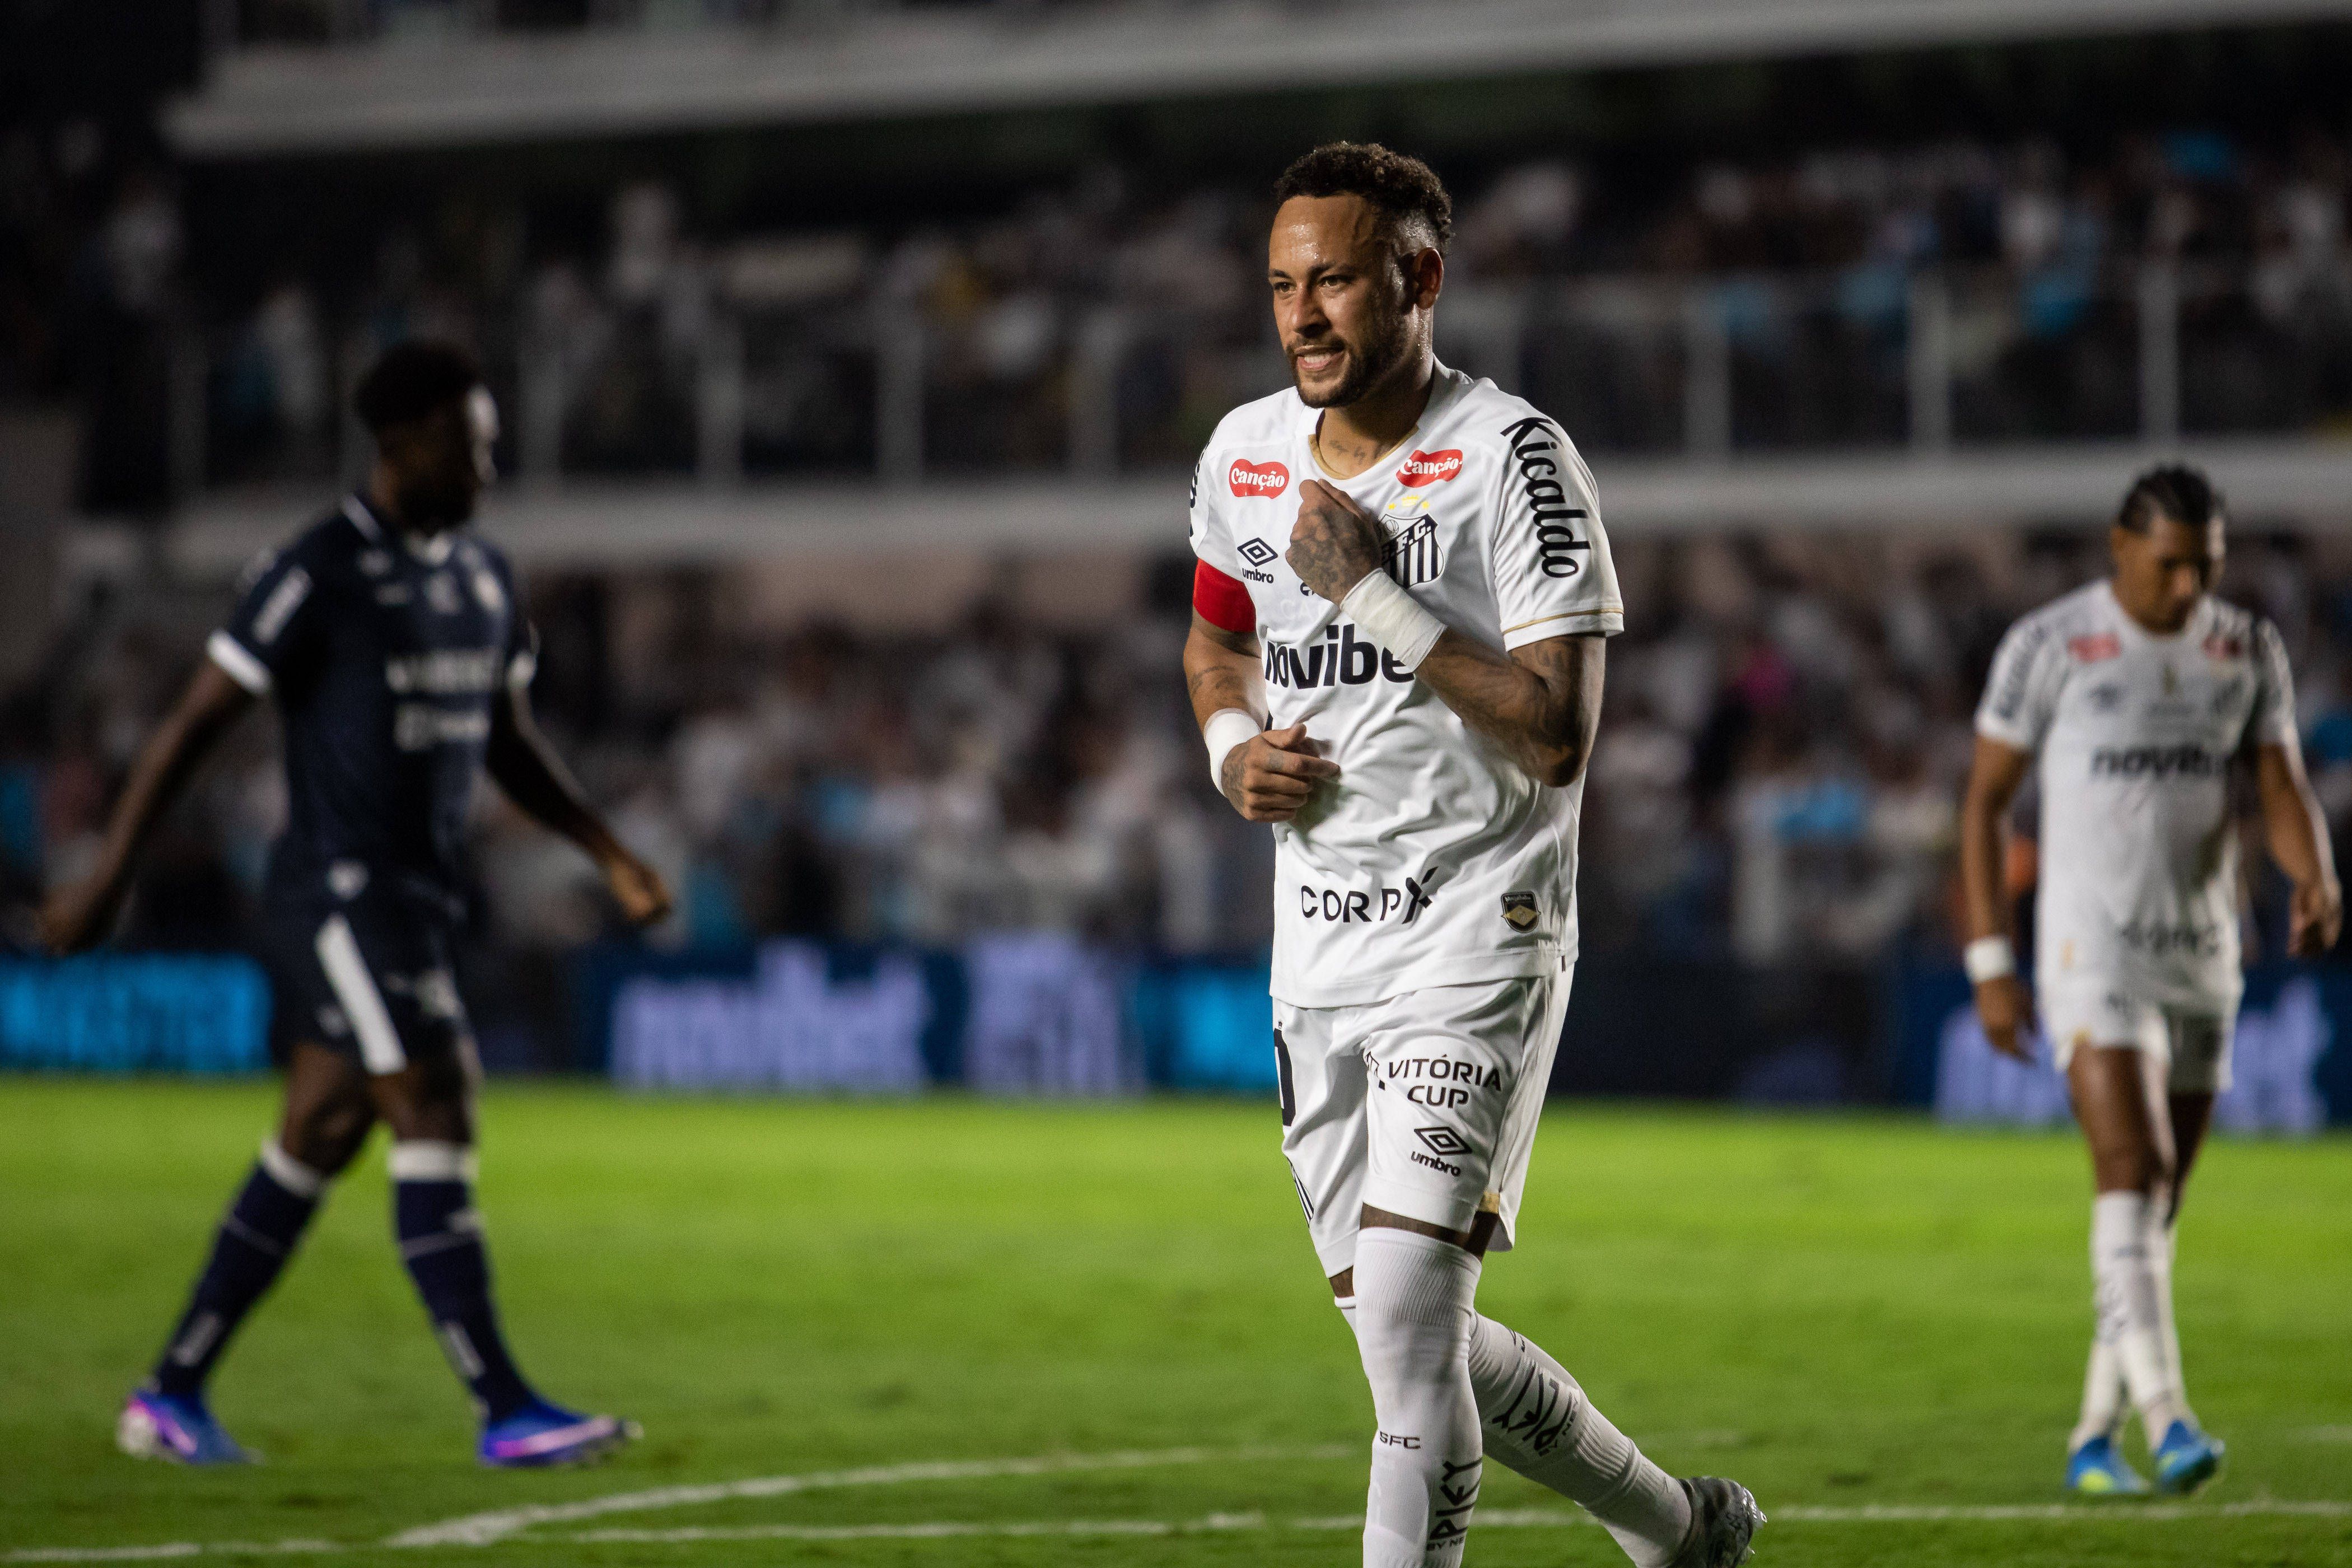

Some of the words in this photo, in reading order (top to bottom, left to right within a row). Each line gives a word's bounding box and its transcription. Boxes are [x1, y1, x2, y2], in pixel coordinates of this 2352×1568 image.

[1231, 467, 1285, 491] Canção
[1399, 457, 1459, 478] Canção
[1500, 417, 1591, 578] Kicaldo
[1242, 568, 1274, 584] umbro
[1264, 623, 1415, 690] novibe
[1388, 1053, 1502, 1091] VITÓRIA
[1407, 1085, 1469, 1109] CUP
[1410, 1151, 1461, 1177] umbro
[1379, 1431, 1421, 1449] SFC
